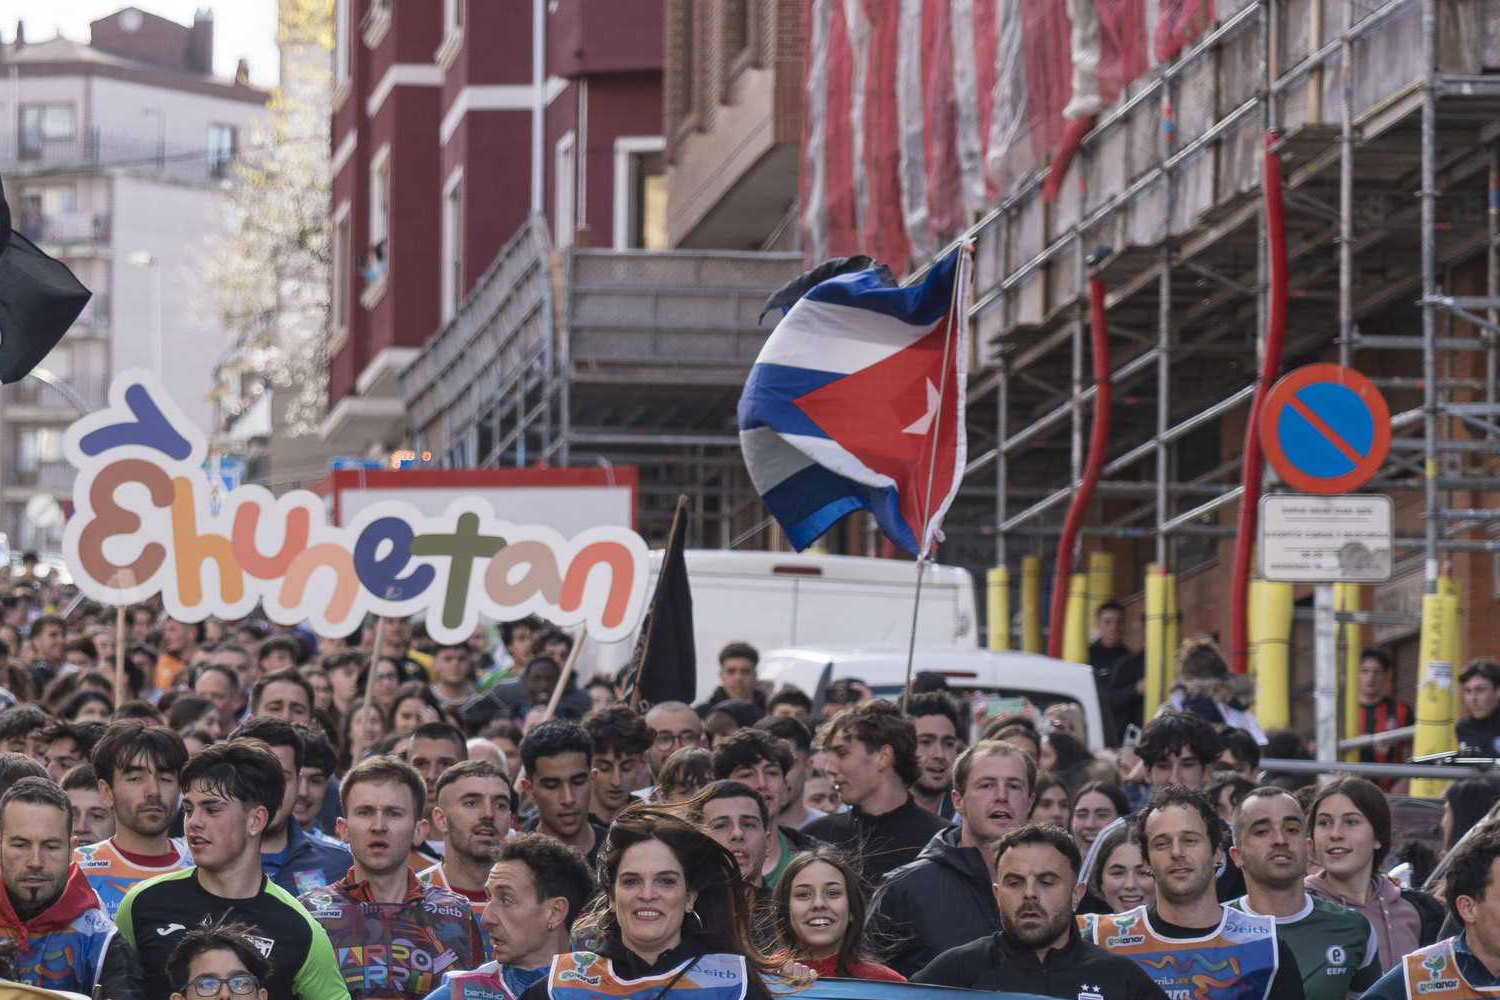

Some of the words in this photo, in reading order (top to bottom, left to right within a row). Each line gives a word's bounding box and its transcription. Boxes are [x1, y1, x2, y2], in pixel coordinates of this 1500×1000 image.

[439, 906, 462, 918] eitb
[1239, 924, 1269, 935] eitb
[704, 965, 737, 980] eitb
[1326, 967, 1347, 975] EEPF
[464, 988, 504, 1000] bertako
